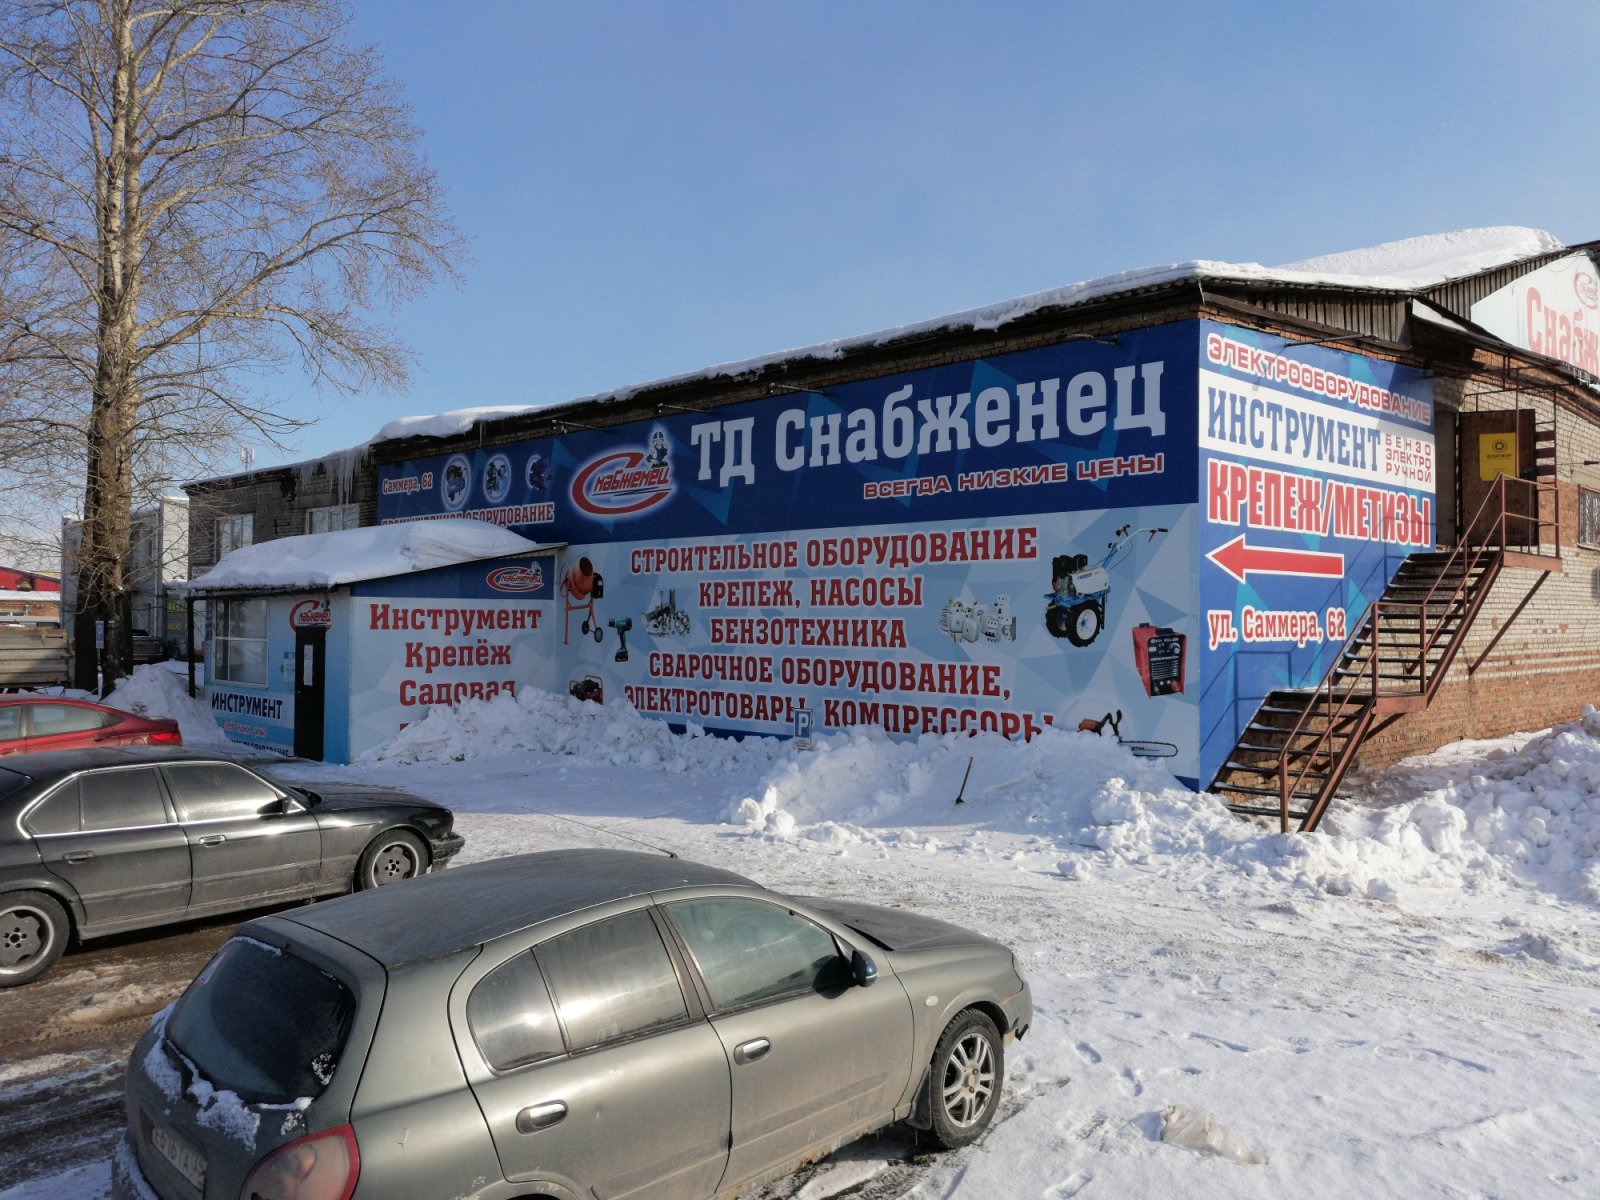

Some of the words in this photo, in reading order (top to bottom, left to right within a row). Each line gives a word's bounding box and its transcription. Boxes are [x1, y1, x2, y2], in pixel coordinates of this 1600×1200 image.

[1207, 333, 1432, 426] ЭЛЕКТРООБОРУДОВАНИЕ
[691, 417, 755, 487] ТД
[775, 361, 1166, 472] Снабженец
[1207, 386, 1381, 472] ИНСТРУМЕНТ
[1385, 433, 1431, 456] БЕНЗО
[1385, 448, 1431, 469] ЭЛЕКТРО
[421, 472, 434, 489] 62
[863, 475, 951, 499] ВСЕГДА
[958, 463, 1068, 491] НИЗКИЕ
[1077, 452, 1165, 479] ЦЕНЫ
[1385, 464, 1431, 483] РУЧНОЙ
[1207, 458, 1432, 547] КРЕПЕЖ/МЕТИЗЫ
[631, 540, 799, 575] СТРОИТЕЛЬНОЕ
[806, 526, 1039, 569] ОБОРУДОВАНИЕ
[699, 580, 801, 609] КРЕПЕЖ,
[810, 577, 924, 607] НАСОСЫ
[369, 603, 543, 636] Инструмент
[711, 617, 907, 649] БЕНЗОТЕХНИКА
[1207, 609, 1238, 650] ул.
[1243, 605, 1324, 648] Саммера,
[1326, 607, 1347, 641] 62
[404, 639, 512, 673] Крепёж
[399, 679, 516, 707] Садовая
[649, 652, 773, 683] СВАРОЧНОЕ
[781, 657, 1011, 701] ОБОРУДОВАНИЕ,
[211, 691, 283, 720] ИНСТРУМЕНТ
[624, 685, 806, 723] ЭЛЕКТРОТОВАРЫ
[824, 699, 1054, 744] КОМПРЕССОРЫ
[797, 713, 809, 736] P
